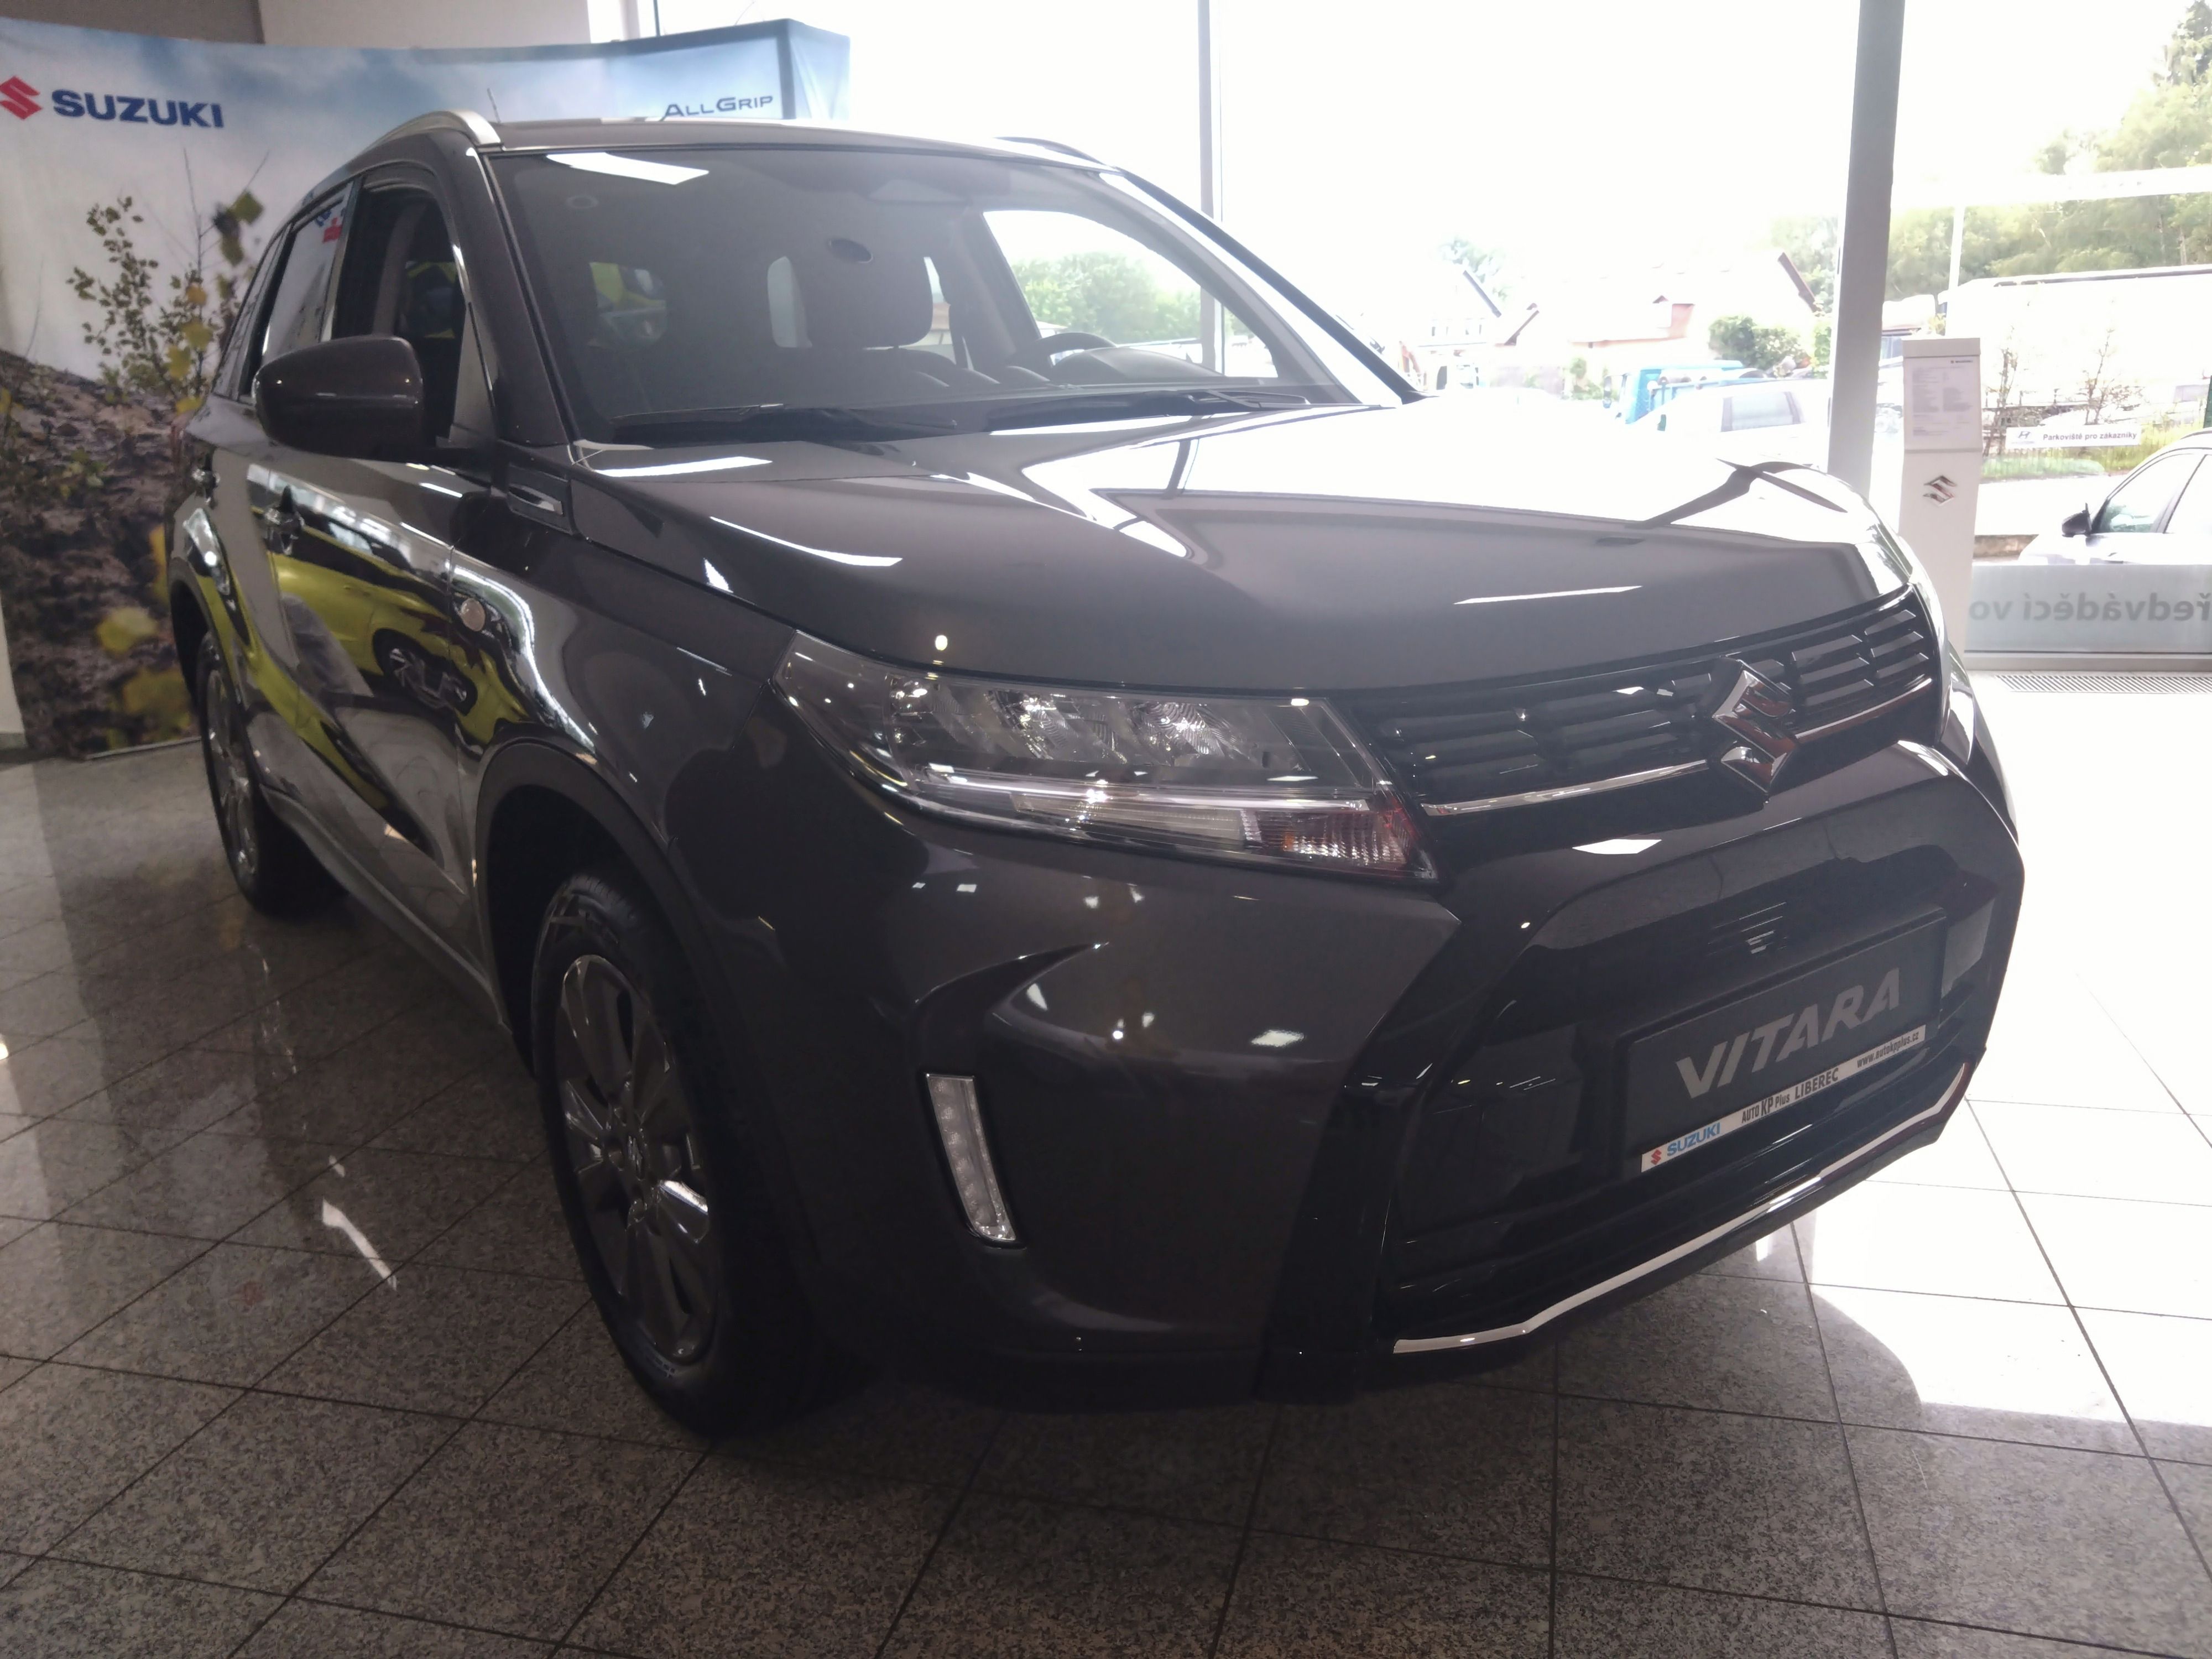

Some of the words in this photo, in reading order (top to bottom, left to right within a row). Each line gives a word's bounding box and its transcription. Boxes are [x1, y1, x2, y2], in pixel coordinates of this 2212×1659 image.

[51, 88, 224, 128] SUZUKI
[2099, 432, 2137, 440] zákazníky
[1676, 967, 1900, 1099] VITARA
[1667, 1122, 1721, 1157] SUZUKI
[1741, 1104, 1760, 1124] AUTO
[1761, 1096, 1773, 1117] KP
[1775, 1093, 1790, 1108] Plus
[1794, 1067, 1839, 1099] LIBEREC
[1857, 1031, 1919, 1068] www.autokpplus.cz
